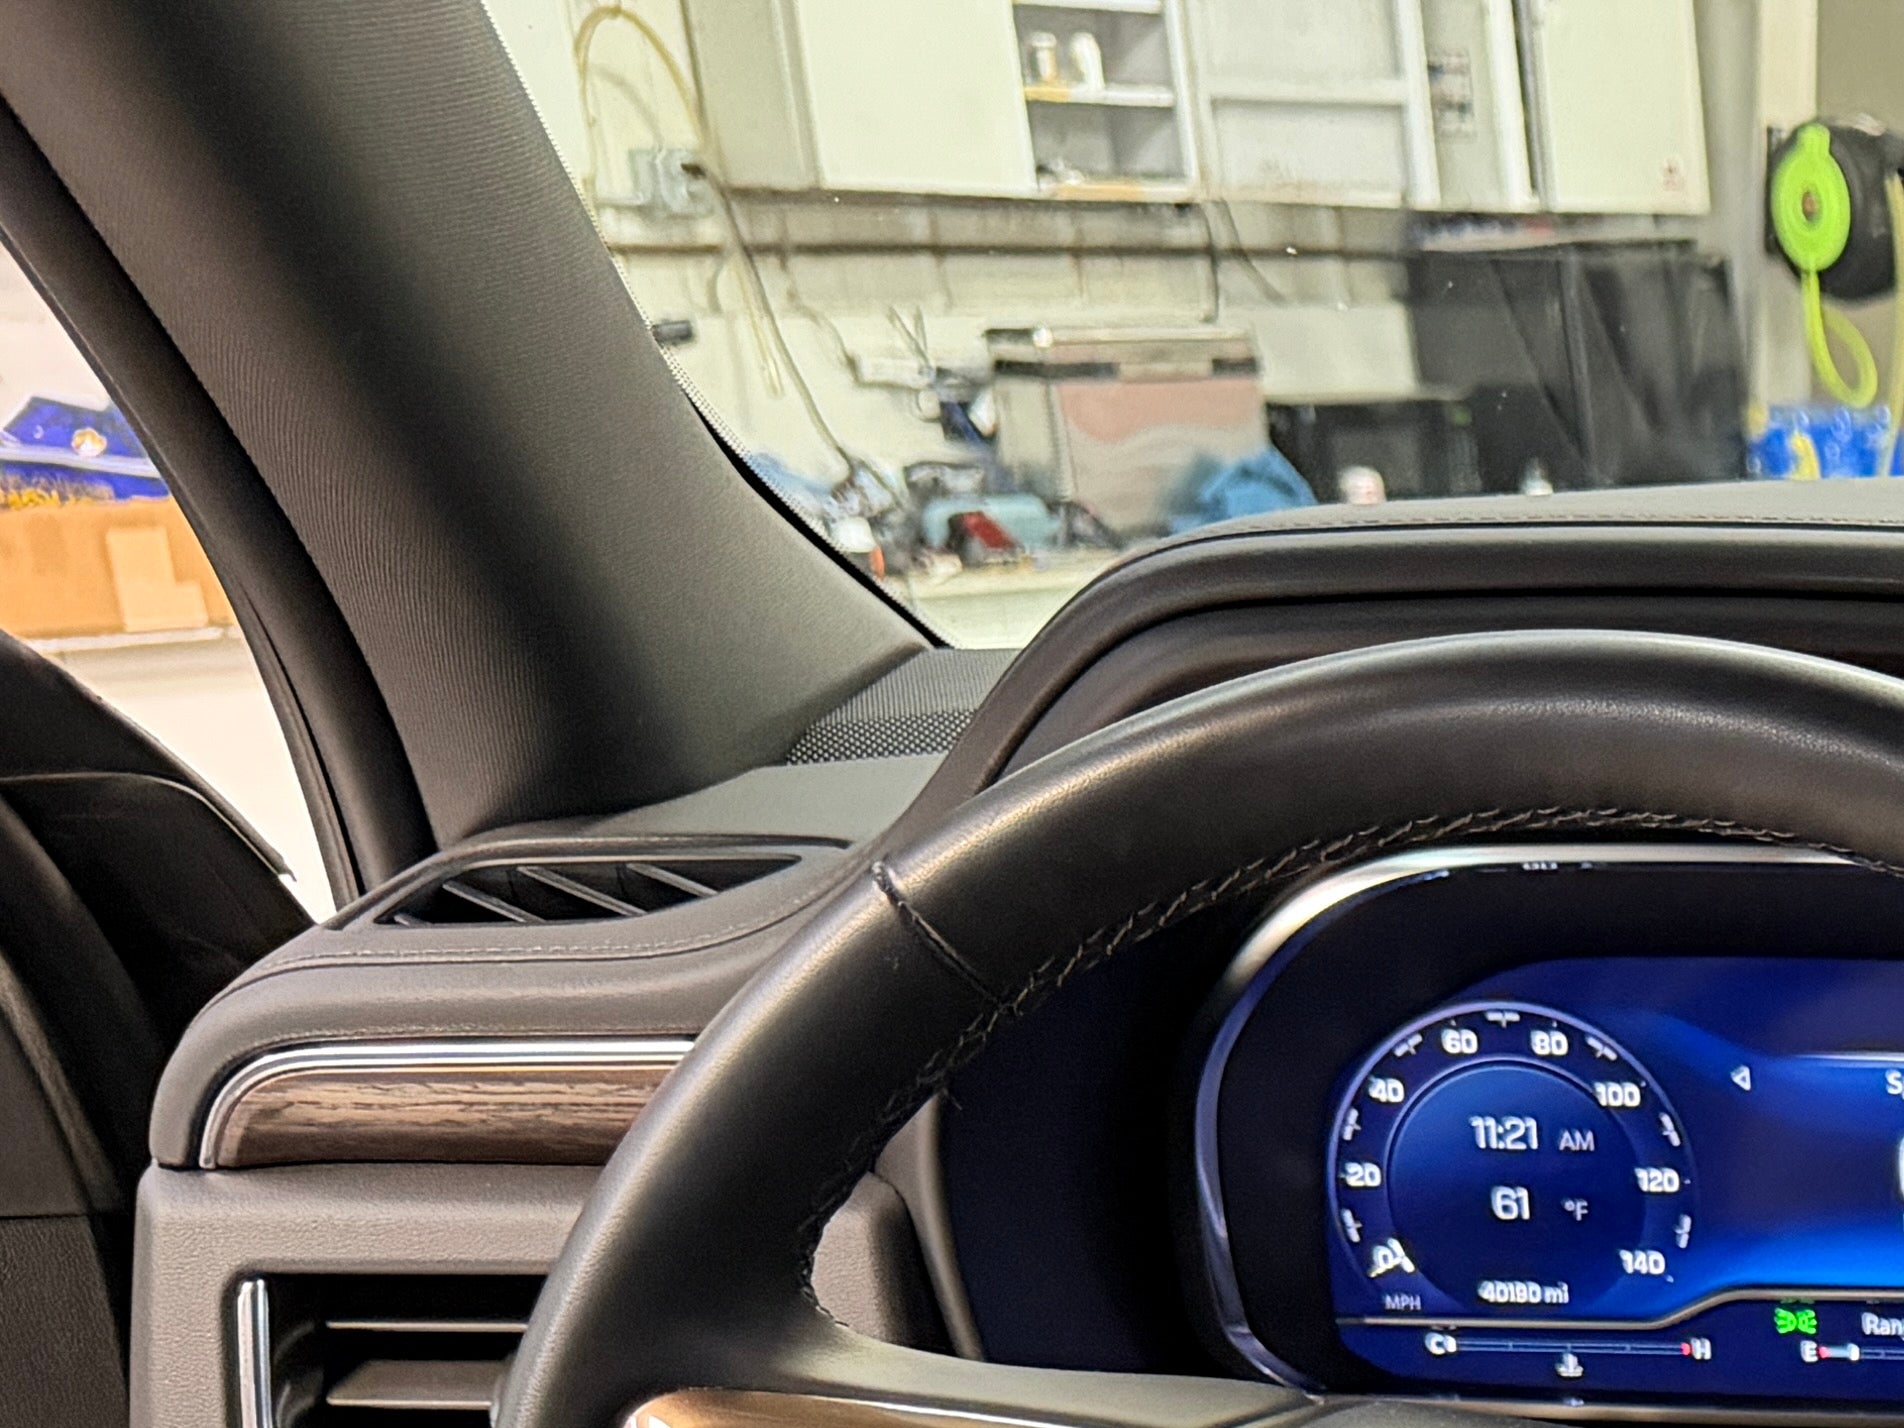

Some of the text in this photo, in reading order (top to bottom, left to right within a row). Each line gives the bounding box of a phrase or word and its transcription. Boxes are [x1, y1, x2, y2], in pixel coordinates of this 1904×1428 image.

[1441, 1029, 1478, 1054] 60
[1530, 1029, 1568, 1056] 80
[1368, 1077, 1405, 1103] 40
[1593, 1081, 1641, 1107] 100
[1469, 1115, 1595, 1152] 11:21 AM
[1344, 1161, 1382, 1187] 20
[1634, 1167, 1680, 1193] 120
[1490, 1185, 1531, 1221] 61
[1619, 1249, 1666, 1275] 140
[1383, 1293, 1422, 1311] MPH
[1543, 1281, 1570, 1304] mi
[1800, 1339, 1818, 1363] E
